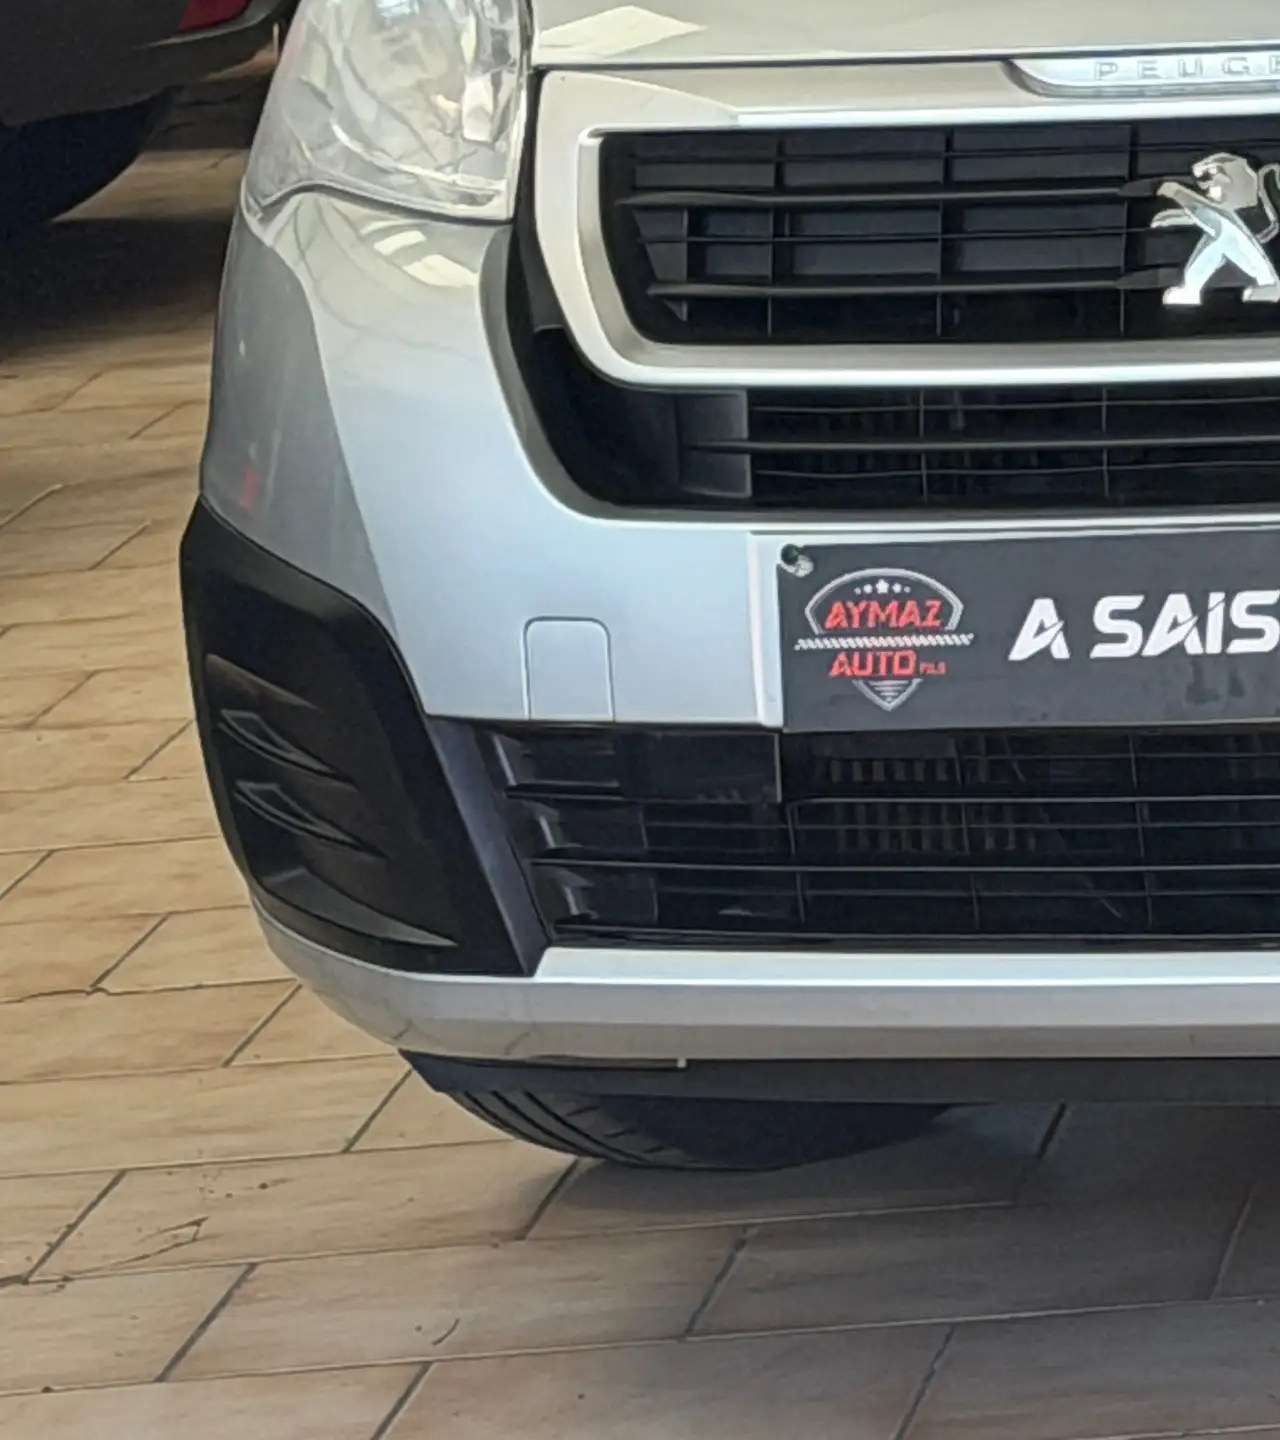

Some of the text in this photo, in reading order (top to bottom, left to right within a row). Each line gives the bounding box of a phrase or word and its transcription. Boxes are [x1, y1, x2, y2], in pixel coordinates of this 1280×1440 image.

[823, 599, 943, 630] AYMAZ
[1008, 597, 1071, 661] A
[828, 648, 917, 678] AUTO
